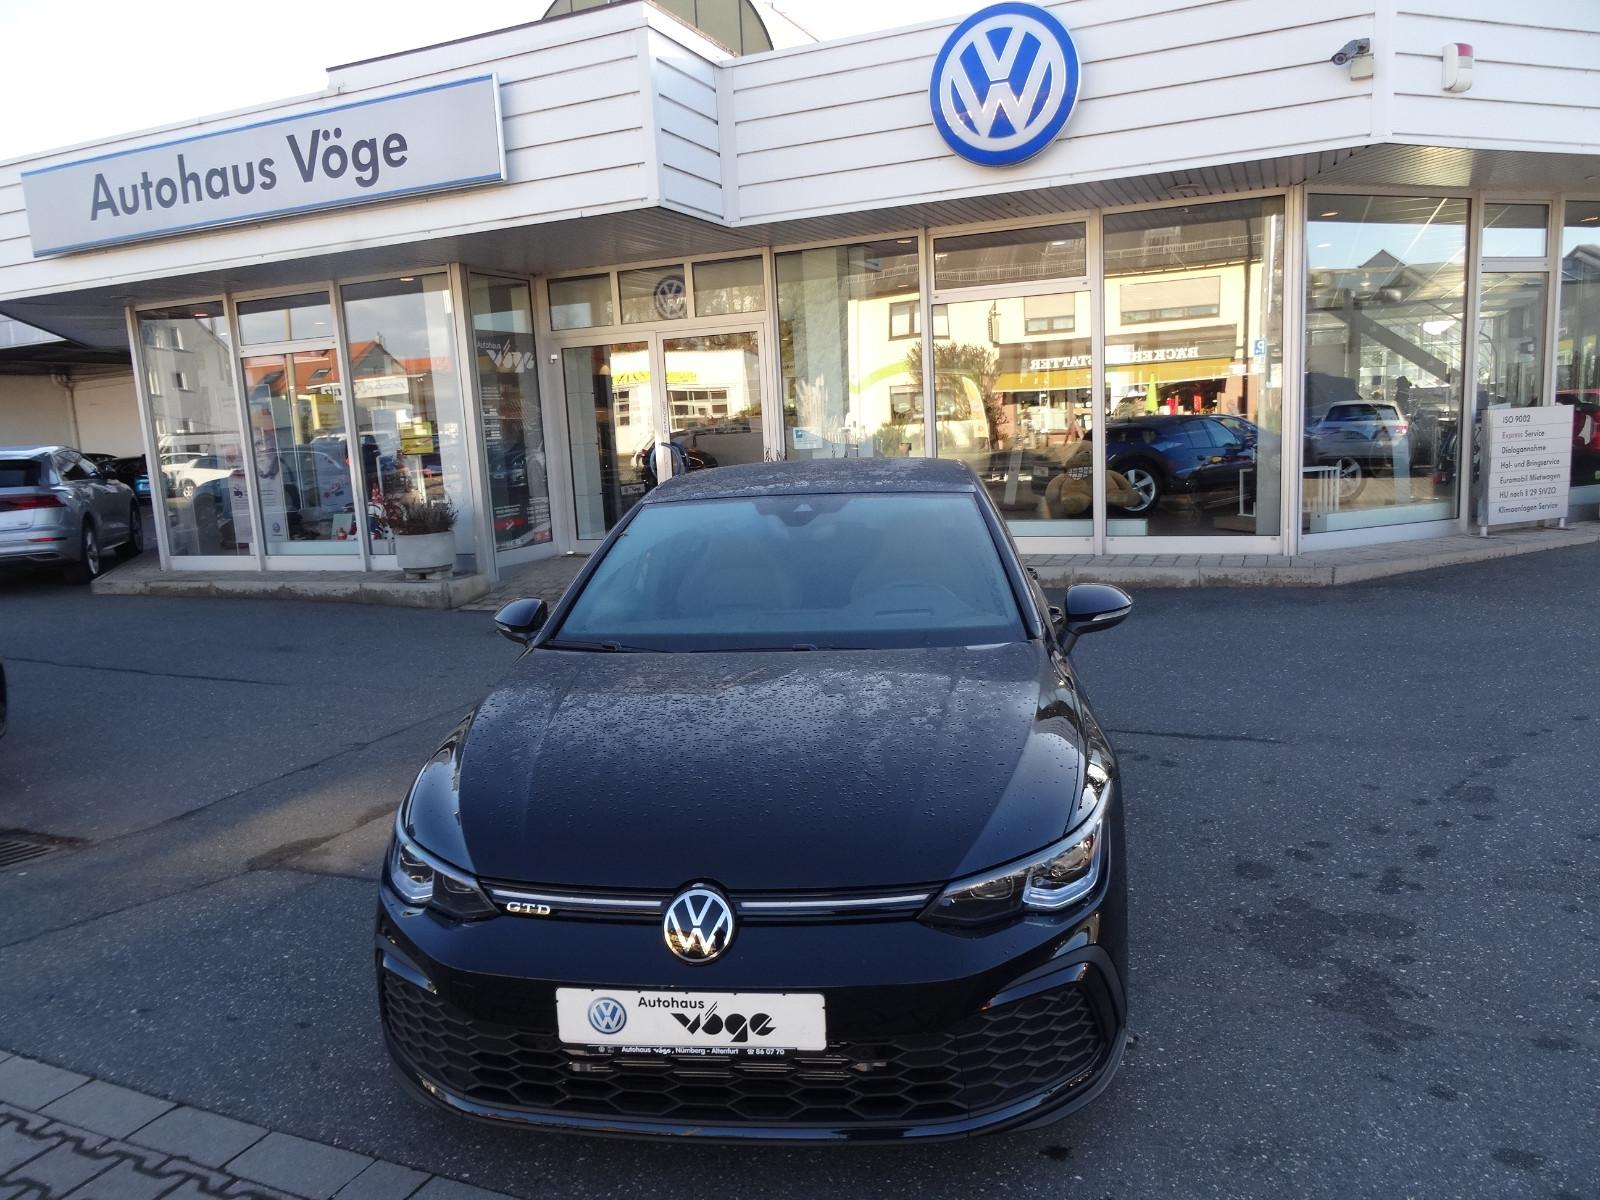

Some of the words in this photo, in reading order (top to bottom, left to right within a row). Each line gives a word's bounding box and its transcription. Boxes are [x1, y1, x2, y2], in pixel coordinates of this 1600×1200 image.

[90, 153, 277, 221] Autohaus
[286, 127, 408, 188] Vöge
[1502, 415, 1514, 424] ISO
[1515, 414, 1531, 423] 9002
[1524, 429, 1545, 438] Service
[1501, 444, 1547, 455] Dialogannahme
[1514, 460, 1525, 468] und
[1526, 458, 1560, 468] Bringservice
[1529, 473, 1561, 482] Mietwagen
[1499, 490, 1509, 499] HU
[1509, 489, 1524, 498] nach
[1529, 488, 1538, 497] 29
[1538, 502, 1559, 511] Service
[506, 901, 551, 916] GTD
[638, 996, 705, 1010] Autohaus
[621, 1046, 652, 1055] Autohaus
[711, 1047, 739, 1056] Altenfurt
[756, 1048, 765, 1056] 86
[766, 1048, 775, 1056] 07
[775, 1048, 785, 1056] 70
